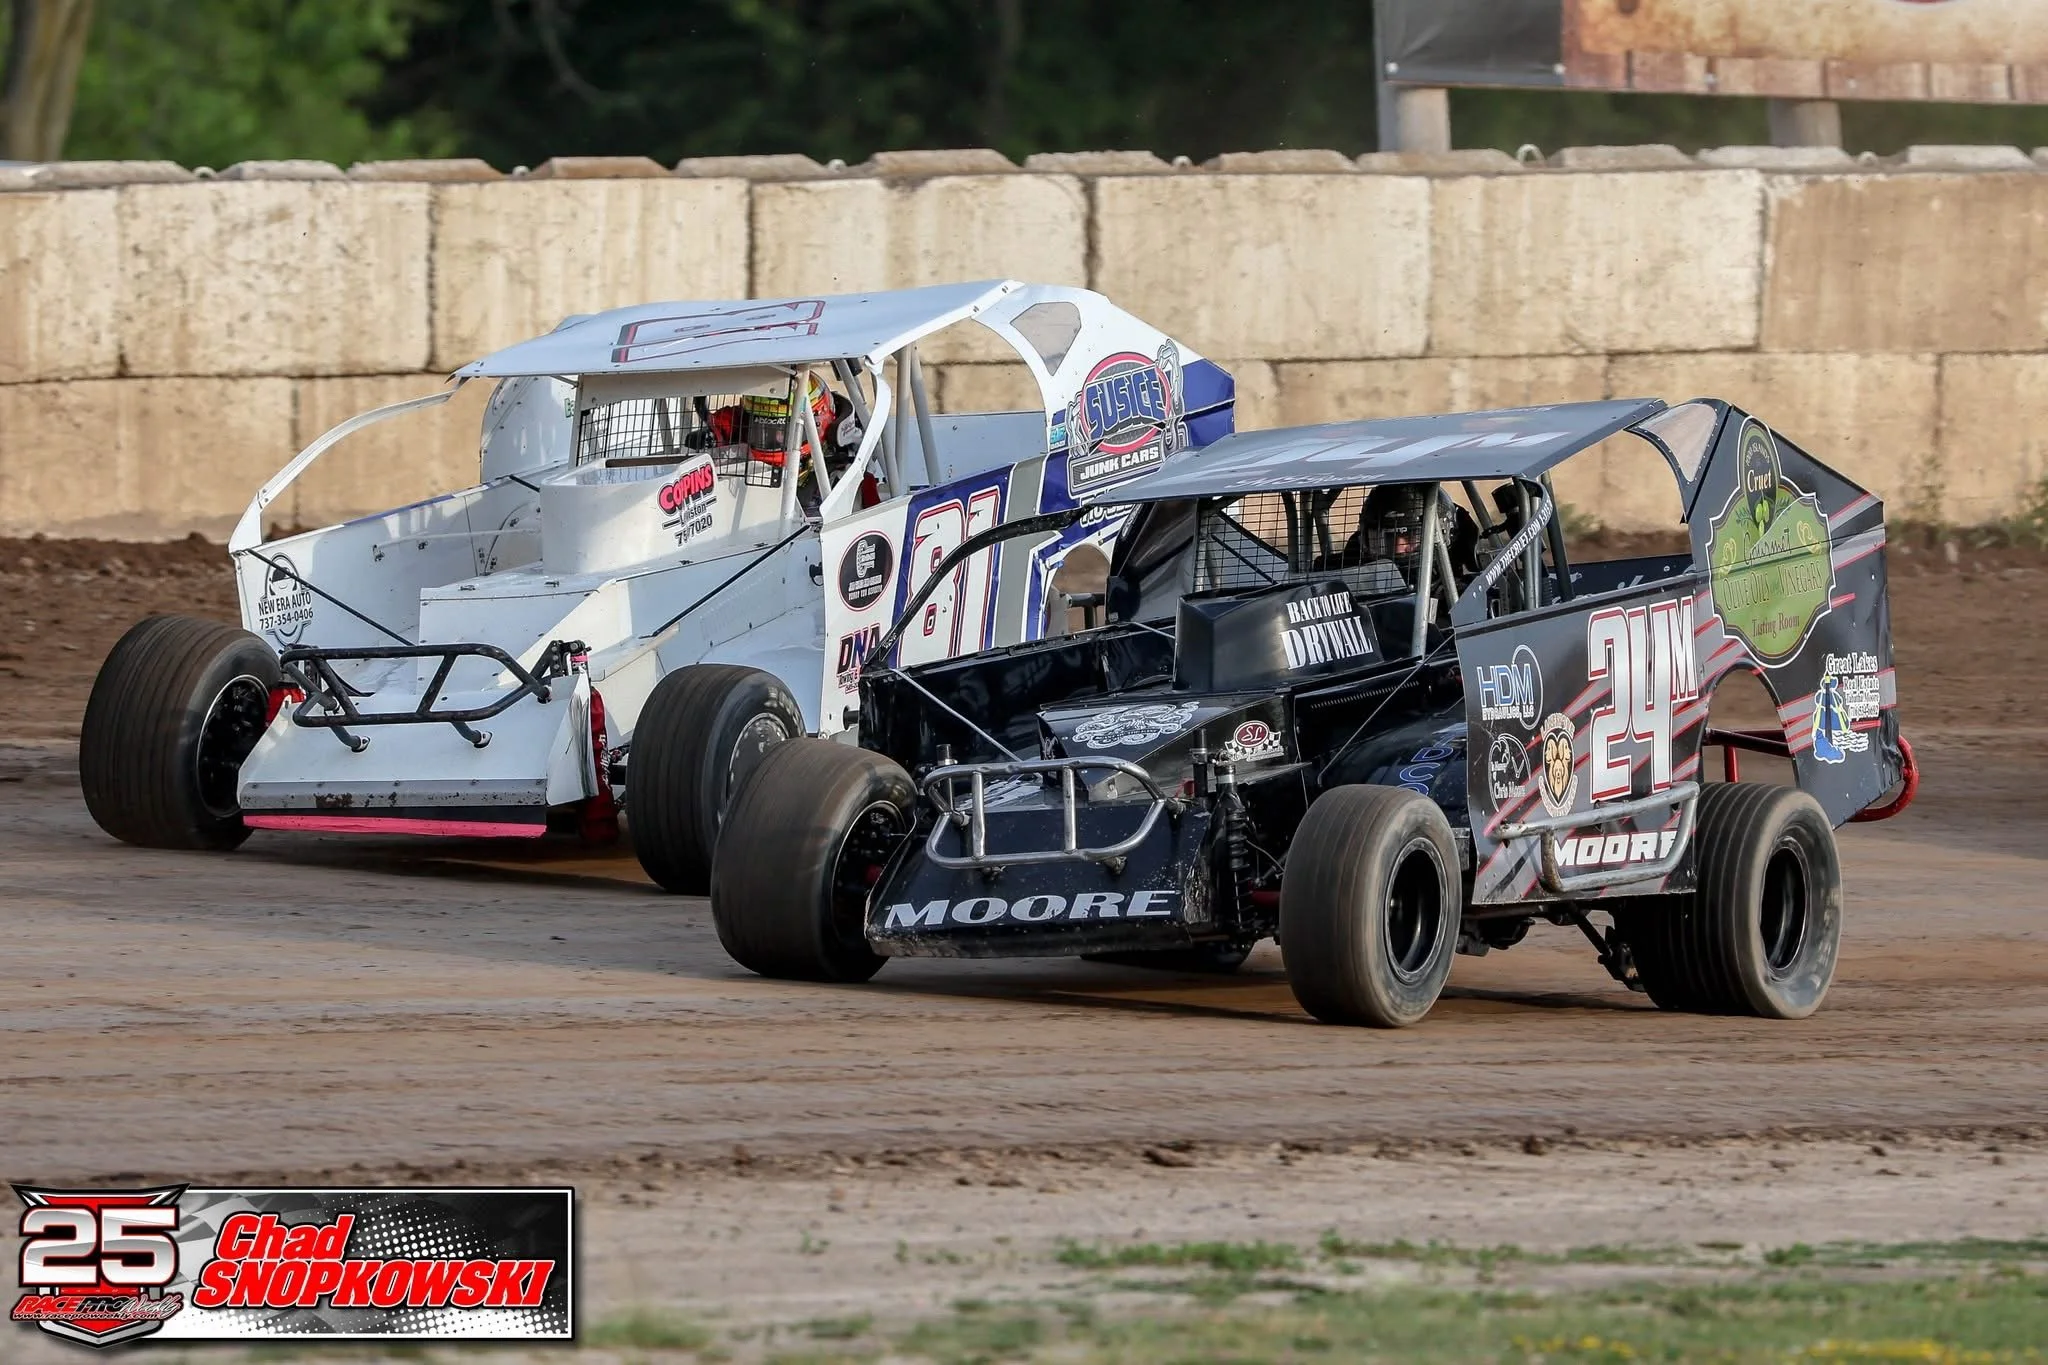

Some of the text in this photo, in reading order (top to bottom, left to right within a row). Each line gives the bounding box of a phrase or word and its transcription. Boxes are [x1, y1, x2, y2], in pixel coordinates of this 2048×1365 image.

[1080, 446, 1159, 481] JUNK CARS
[1747, 469, 1772, 493] Cruet
[258, 592, 311, 616] NEW ERA AUTO
[1286, 591, 1353, 624] BACK TO LIFE
[259, 607, 314, 630] 737-354-0406
[1778, 612, 1800, 632] Room
[1279, 616, 1374, 670] DRYWALL
[1827, 651, 1878, 675] Great Lakes
[1477, 663, 1534, 708] HDM
[884, 890, 1182, 929] MOORE
